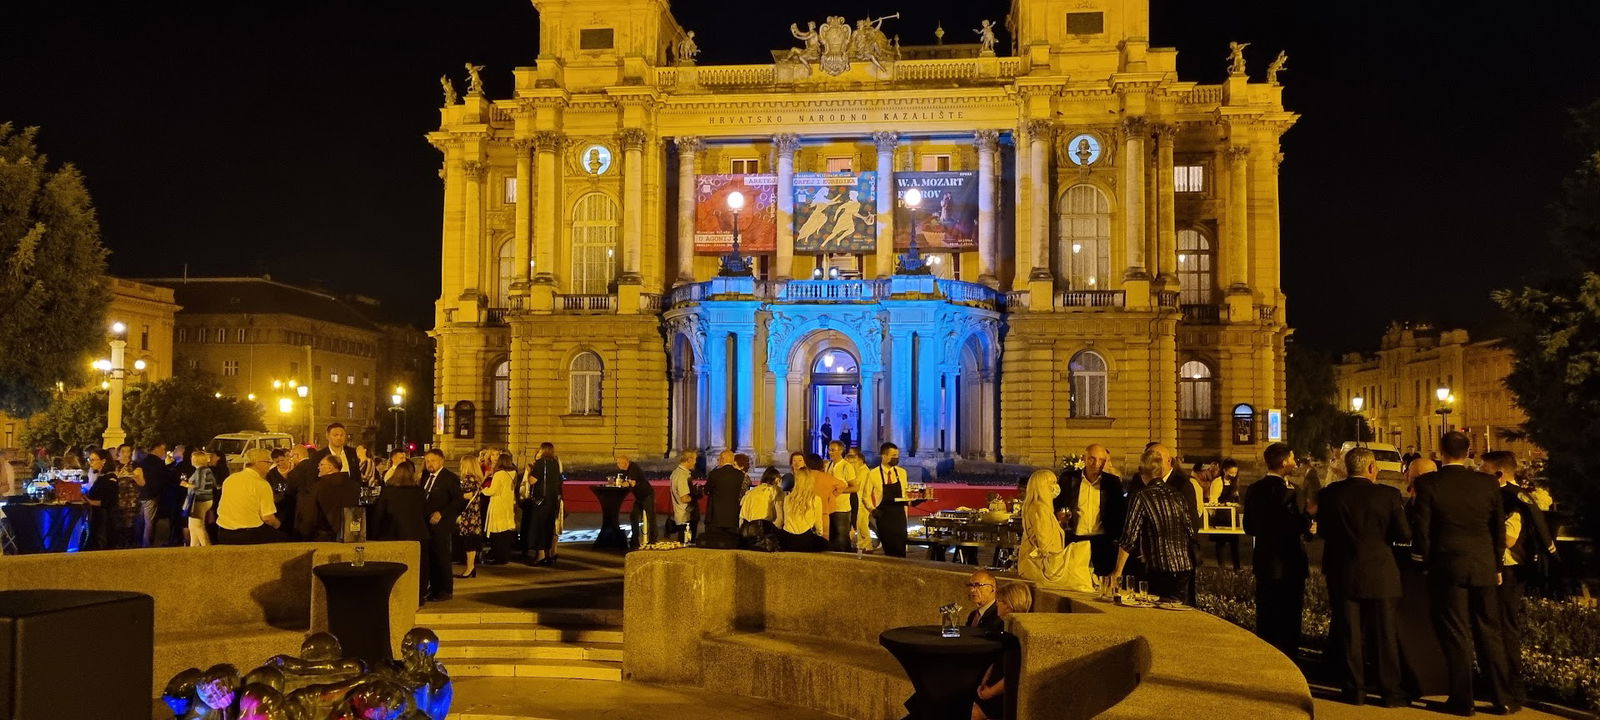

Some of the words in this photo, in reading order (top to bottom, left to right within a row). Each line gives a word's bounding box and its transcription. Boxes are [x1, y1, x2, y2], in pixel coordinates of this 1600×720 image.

[709, 116, 783, 124] HRVATSKO
[799, 113, 868, 122] NARODNO
[883, 111, 964, 120] KAZALIŠTE
[897, 178, 910, 187] W.
[911, 178, 920, 187] A.
[921, 177, 964, 187] MOZART
